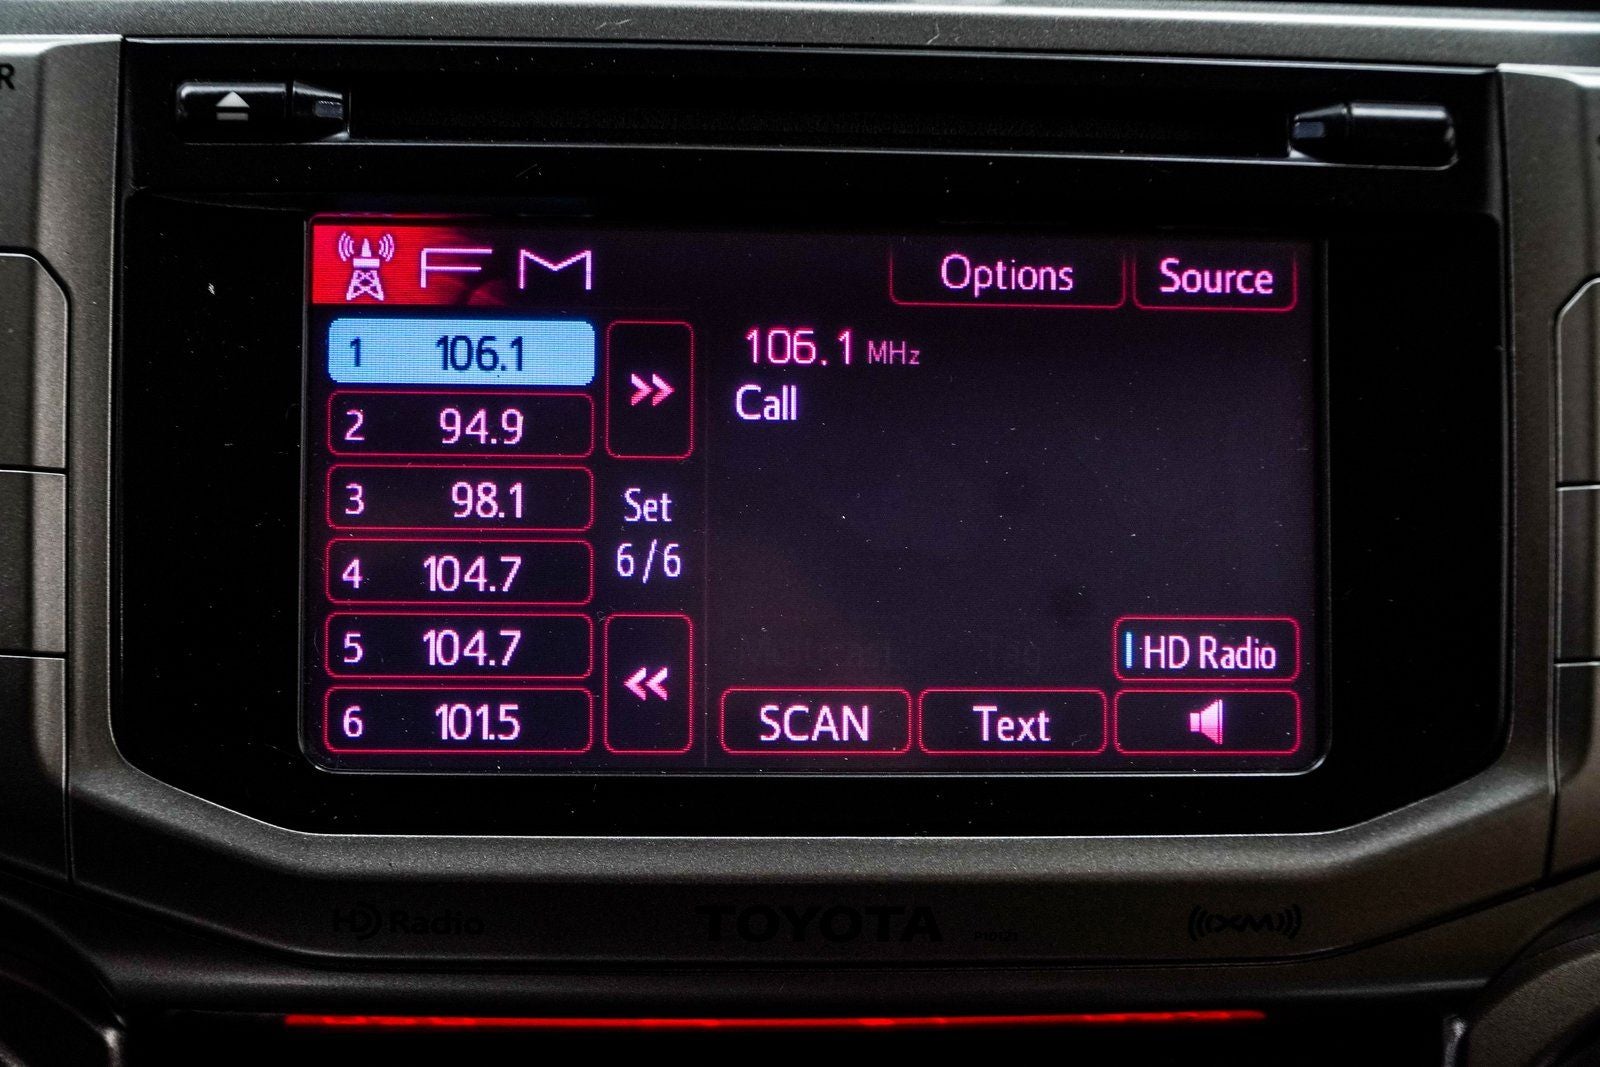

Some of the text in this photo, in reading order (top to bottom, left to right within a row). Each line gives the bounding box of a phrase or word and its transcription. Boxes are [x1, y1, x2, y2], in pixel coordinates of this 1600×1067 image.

[419, 247, 593, 291] FM
[940, 253, 1075, 298] Options
[1157, 257, 1275, 296] Source
[349, 335, 525, 372] 1 106.1
[744, 326, 922, 367] 106.1 MHz
[735, 384, 798, 421] Call
[344, 407, 525, 446] 2 94.9
[344, 481, 524, 519] 3 98.1
[623, 487, 673, 523] Set
[341, 555, 522, 593] 4 104.7
[615, 538, 683, 584] 6/6
[343, 629, 522, 667] 5 104.7
[1143, 634, 1277, 671] HD Radio
[342, 703, 521, 741] 6 101.5
[758, 704, 870, 743] SCAN
[972, 704, 1052, 743] Text
[390, 909, 485, 935] Radio
[695, 904, 943, 943] TOYOTA
